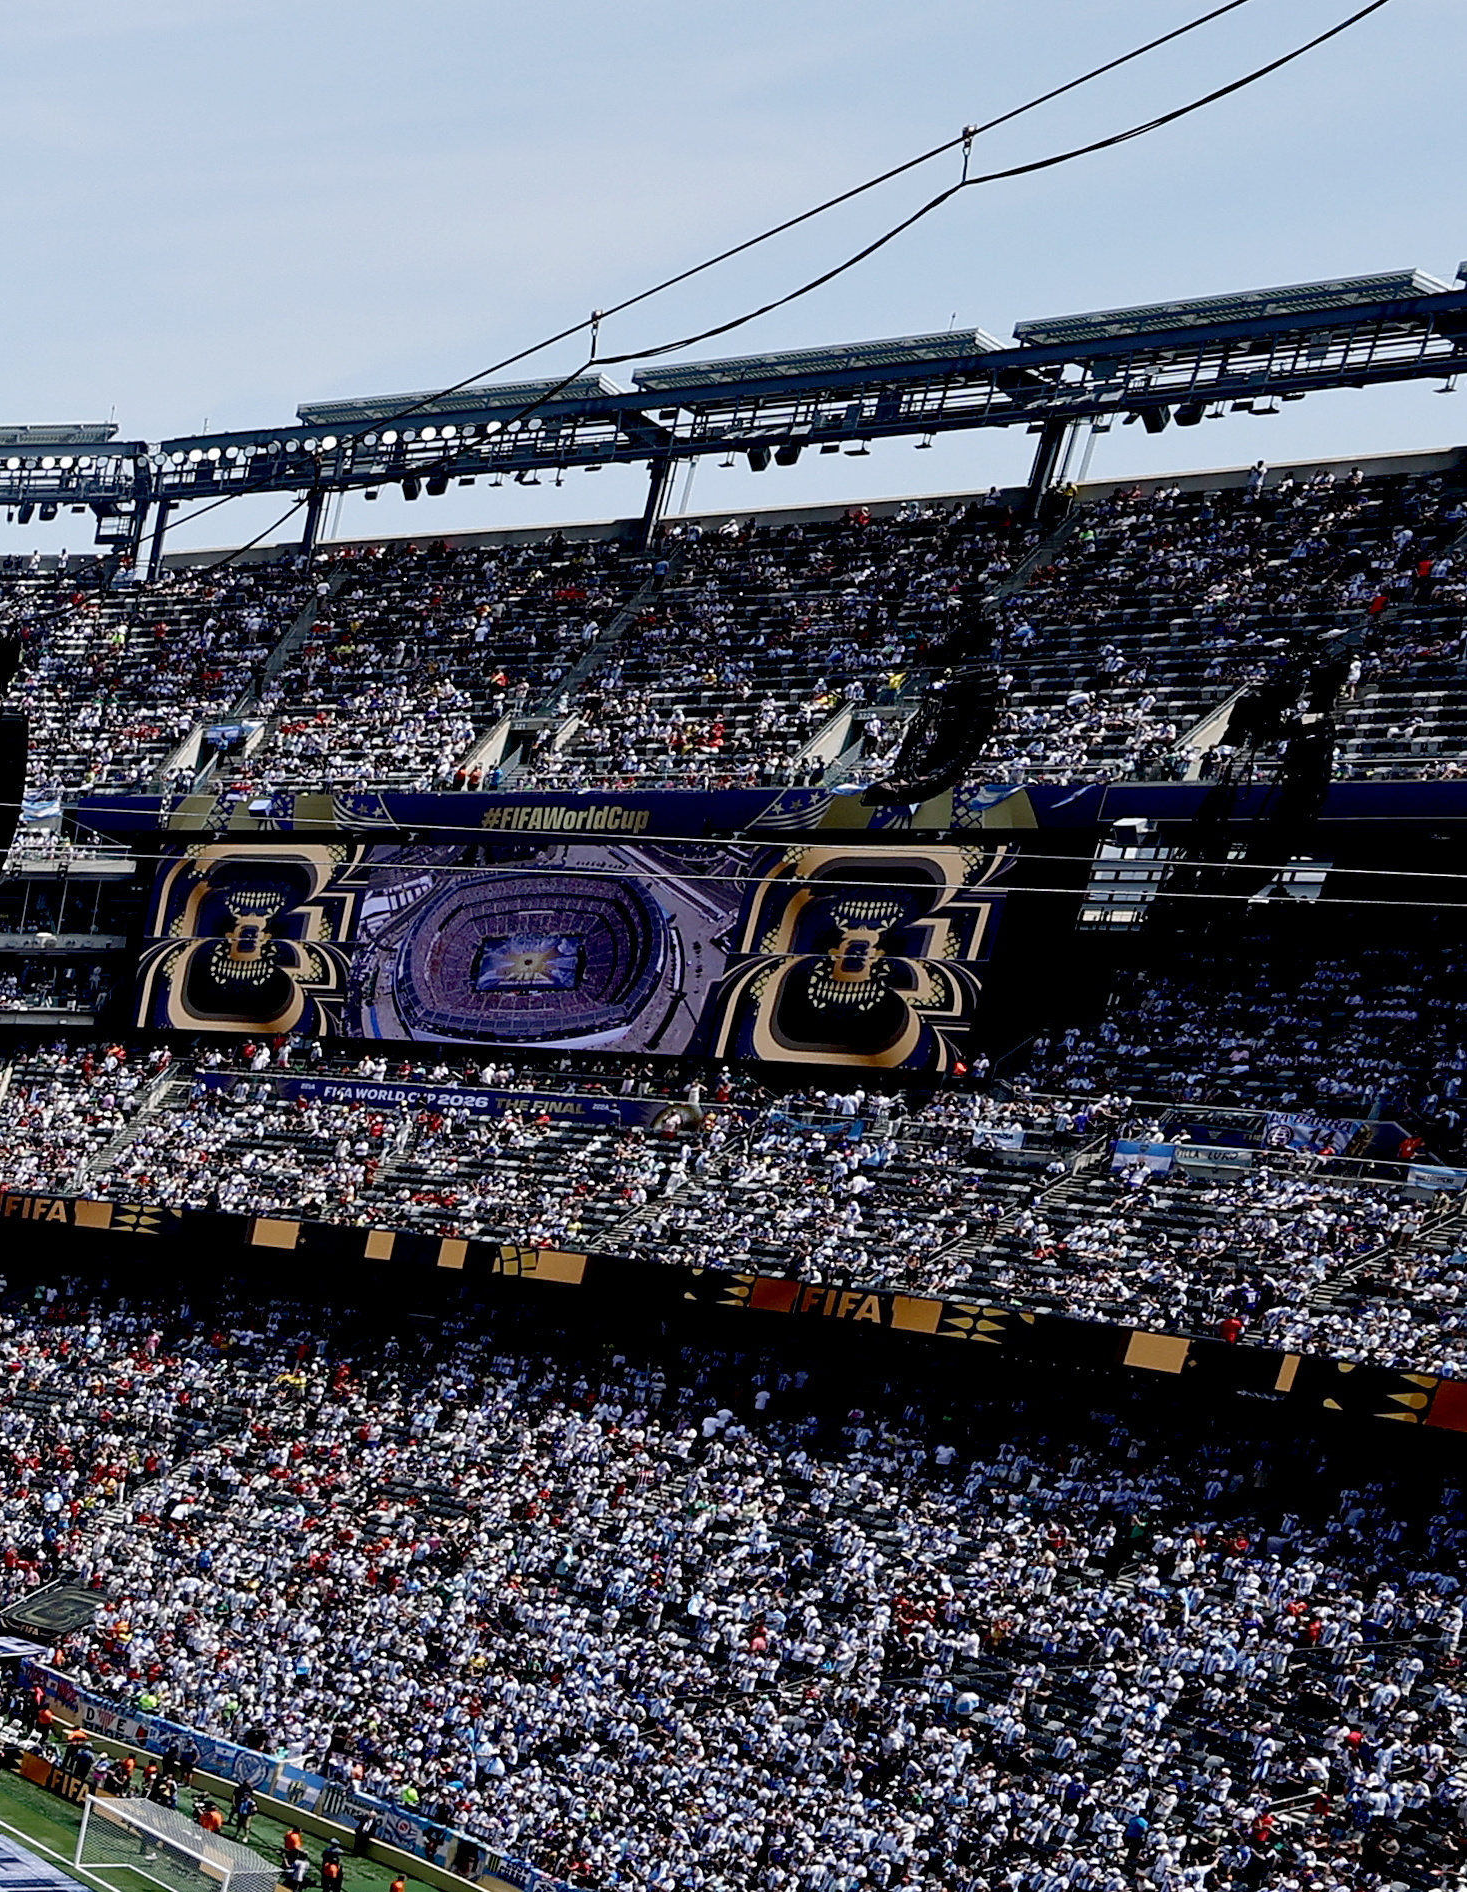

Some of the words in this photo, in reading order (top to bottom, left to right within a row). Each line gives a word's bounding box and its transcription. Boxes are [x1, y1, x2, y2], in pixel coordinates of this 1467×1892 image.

[482, 806, 649, 833] #FIFAWorldCup
[356, 1089, 406, 1102] WORLD
[438, 1095, 489, 1107] 2026
[496, 1097, 531, 1111] THE
[536, 1100, 586, 1114] FINAL
[2, 1195, 68, 1222] FIFA
[800, 1286, 882, 1323] FIFA
[49, 1769, 90, 1803] FIFA
